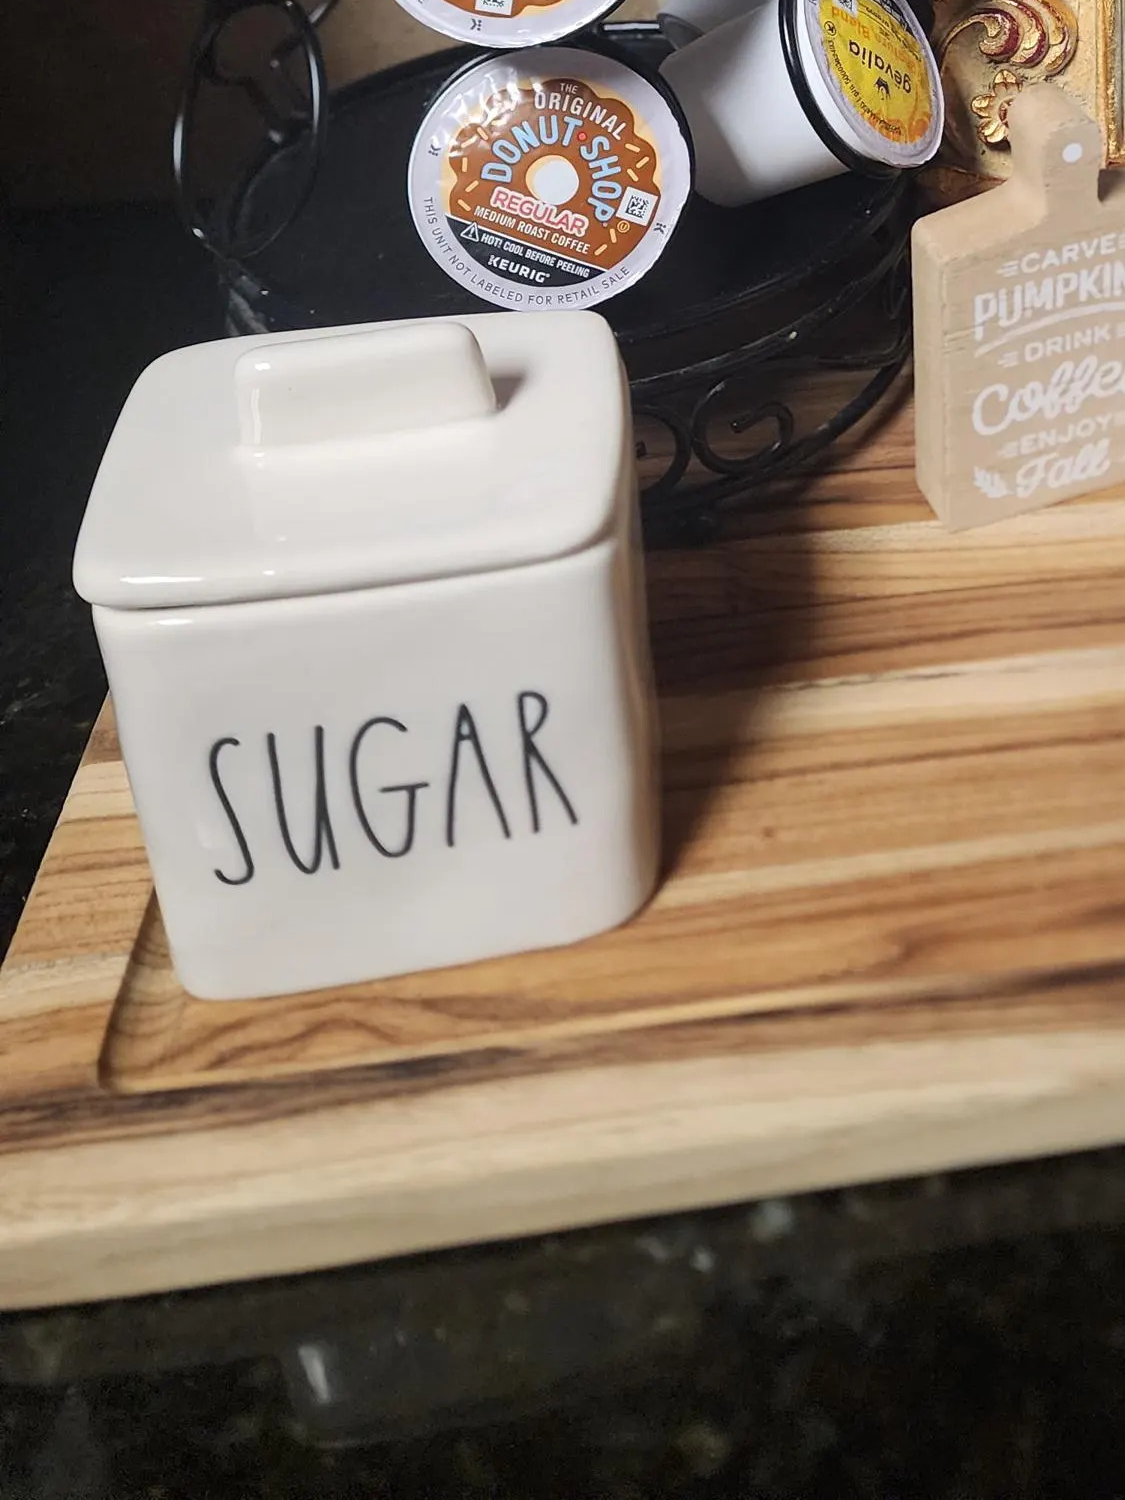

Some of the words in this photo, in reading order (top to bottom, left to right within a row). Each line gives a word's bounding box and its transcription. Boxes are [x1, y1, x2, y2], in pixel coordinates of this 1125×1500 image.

[559, 82, 579, 94] THE
[534, 91, 628, 141] ORIGINAL
[480, 114, 584, 184] DONUT
[580, 134, 623, 222] SHOP
[474, 204, 516, 229] MEDIUM
[516, 218, 550, 242] ROAST
[551, 231, 591, 255] COFFEE
[490, 186, 590, 238] REGULAR
[423, 196, 438, 226] THIS
[431, 227, 452, 256] UNIT
[448, 252, 472, 278] NOT
[470, 274, 524, 304] LABELED
[527, 294, 553, 306] FOR
[556, 285, 600, 306] RETAIL
[601, 265, 631, 290] SALE
[480, 232, 503, 250] HOT!
[503, 240, 523, 257] COOL
[524, 248, 556, 268] BEFORE
[556, 258, 590, 279] PEELING
[488, 254, 549, 284] KEURIG
[1020, 232, 1117, 274] CARVE
[1023, 322, 1111, 363] DRINK
[1019, 411, 1113, 455] ENJOY
[1015, 437, 1112, 498] Fall
[208, 690, 580, 887] SUGAR
